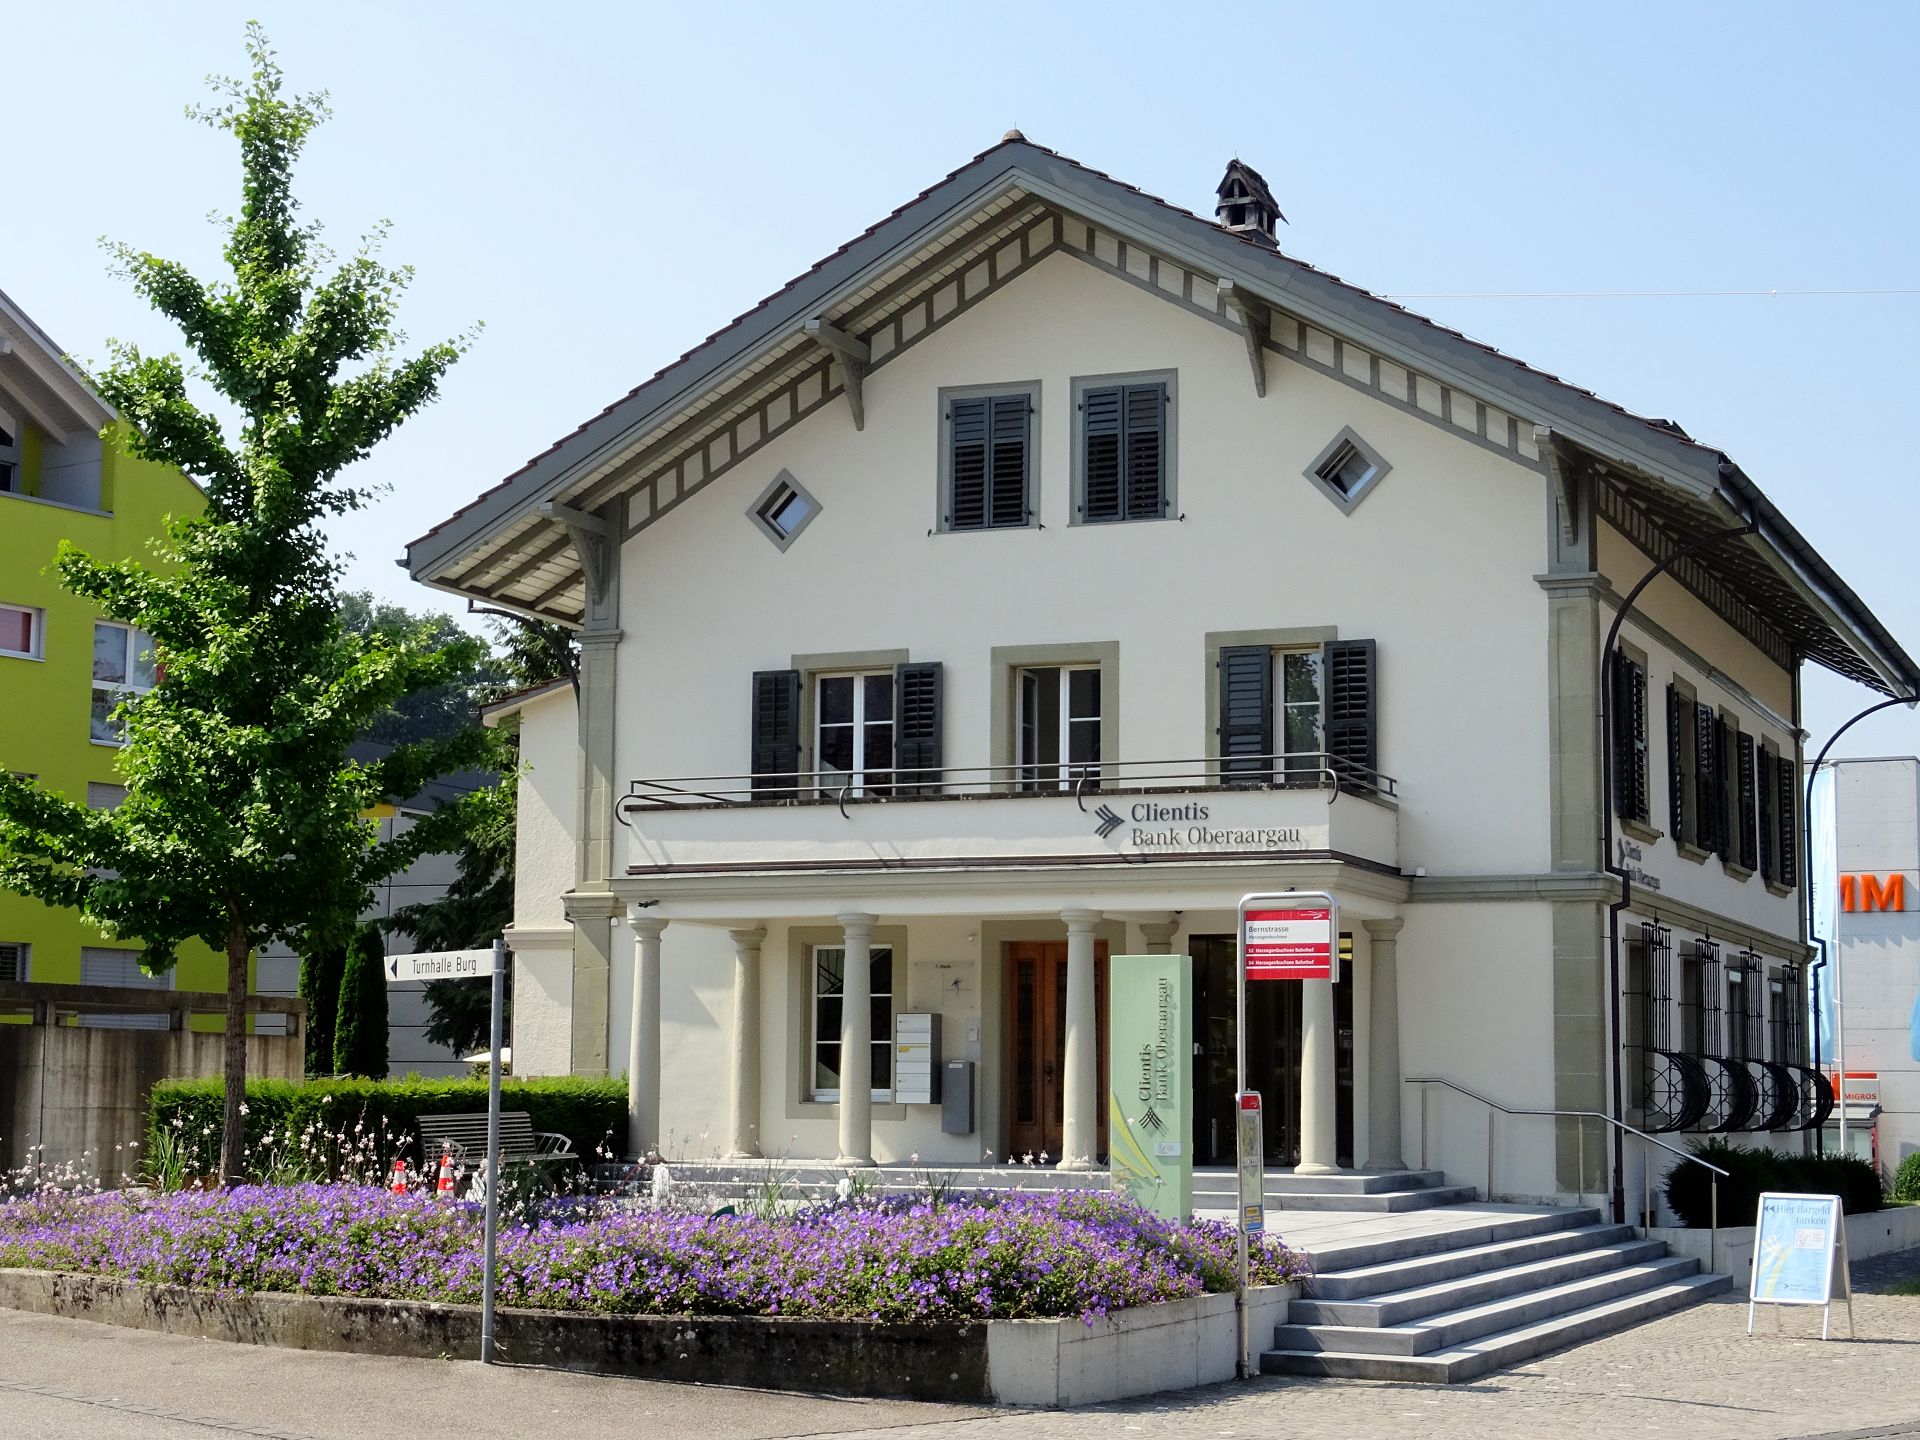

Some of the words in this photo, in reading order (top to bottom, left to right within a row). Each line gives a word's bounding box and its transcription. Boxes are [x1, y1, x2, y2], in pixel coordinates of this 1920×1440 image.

[1131, 802, 1209, 822] Clientis
[1132, 828, 1181, 846] Bank
[1188, 826, 1300, 847] Oberaargau
[412, 958, 452, 974] Turnhalle
[456, 956, 477, 975] Burg
[1155, 977, 1171, 1060] Oberaargau
[1138, 1043, 1152, 1102] Clientis
[1156, 1063, 1168, 1101] Bank
[1776, 1204, 1795, 1214] Hier
[1797, 1205, 1831, 1215] Bargeld
[1796, 1216, 1827, 1225] tanken
